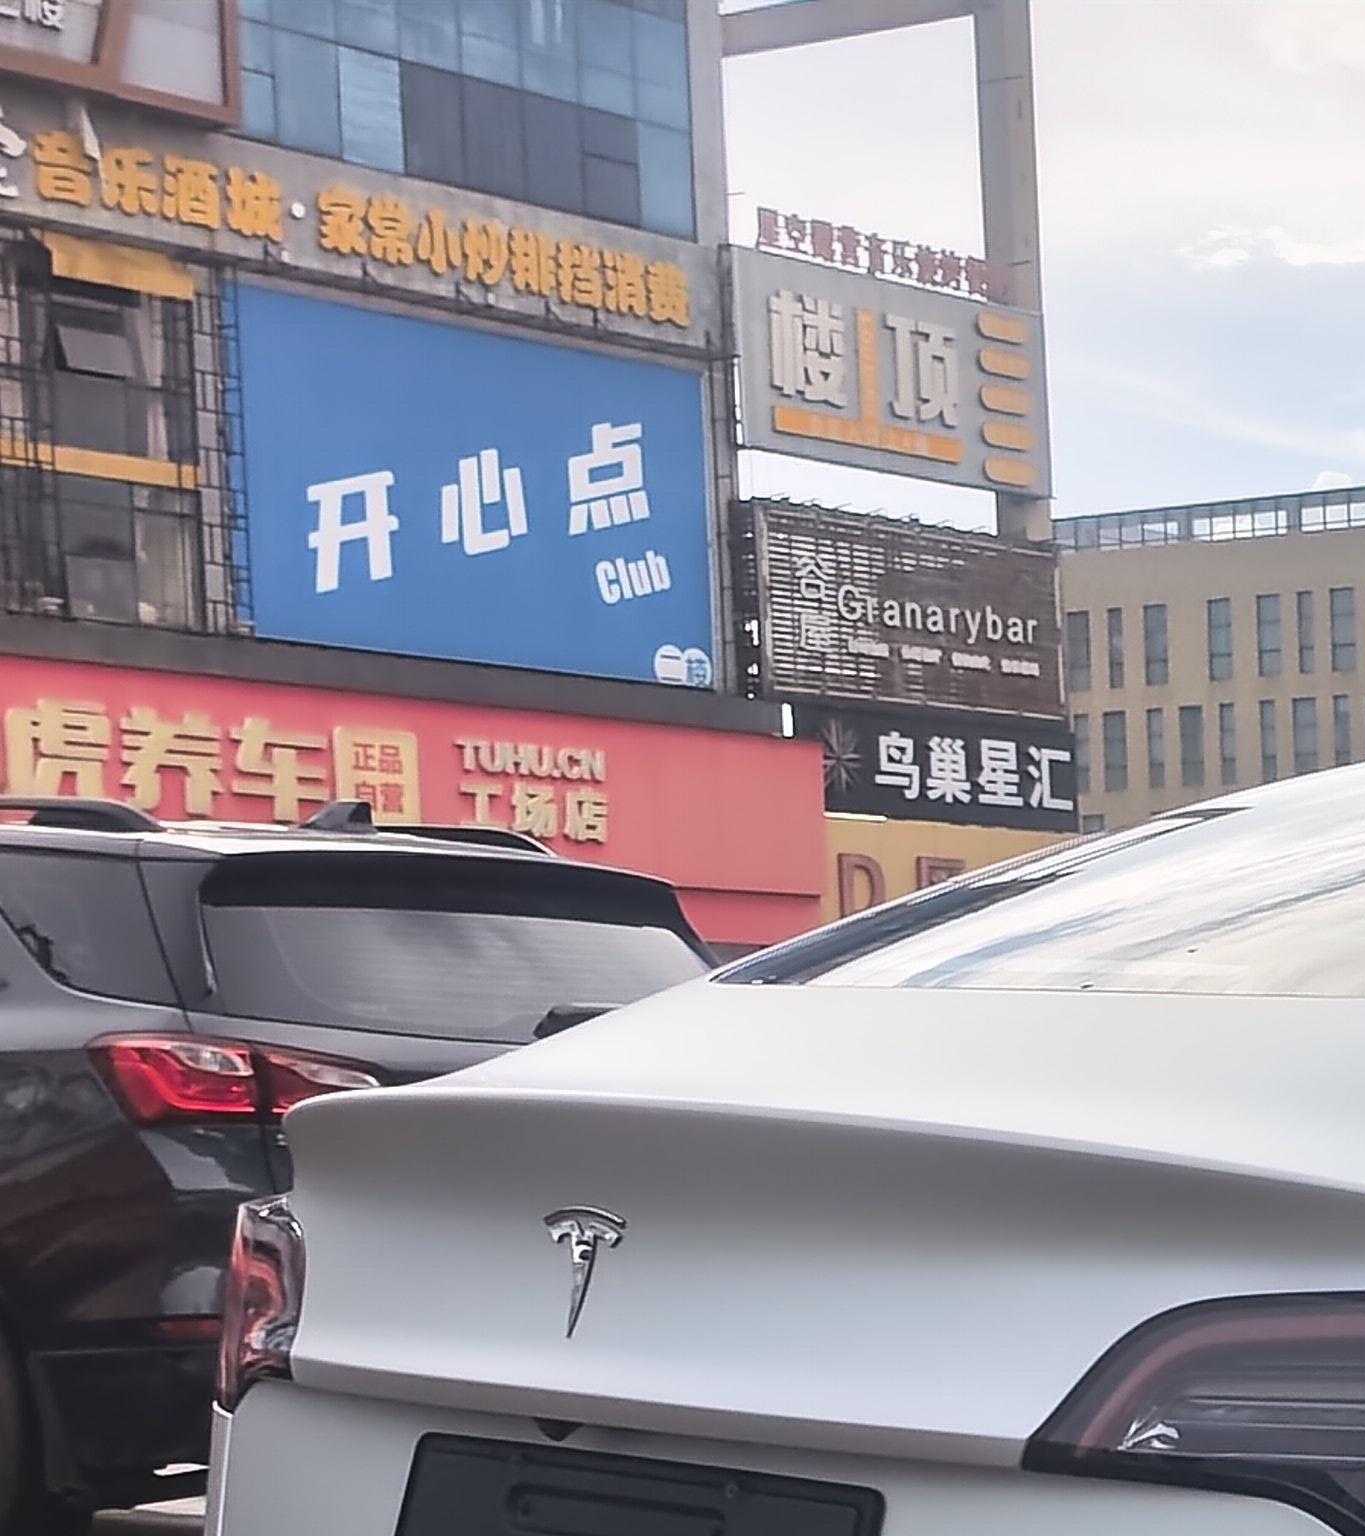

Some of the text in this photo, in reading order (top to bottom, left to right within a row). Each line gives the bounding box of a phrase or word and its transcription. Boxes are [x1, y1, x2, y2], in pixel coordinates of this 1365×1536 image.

[767, 288, 957, 428] 楼顶
[306, 422, 652, 594] 开心点
[595, 550, 672, 606] Club
[837, 584, 1039, 645] Granarybar
[353, 741, 403, 775] 正品
[454, 737, 606, 782] TUHU.CN
[874, 731, 1074, 812] 鸟巢星汇
[459, 780, 608, 844] 工场店
